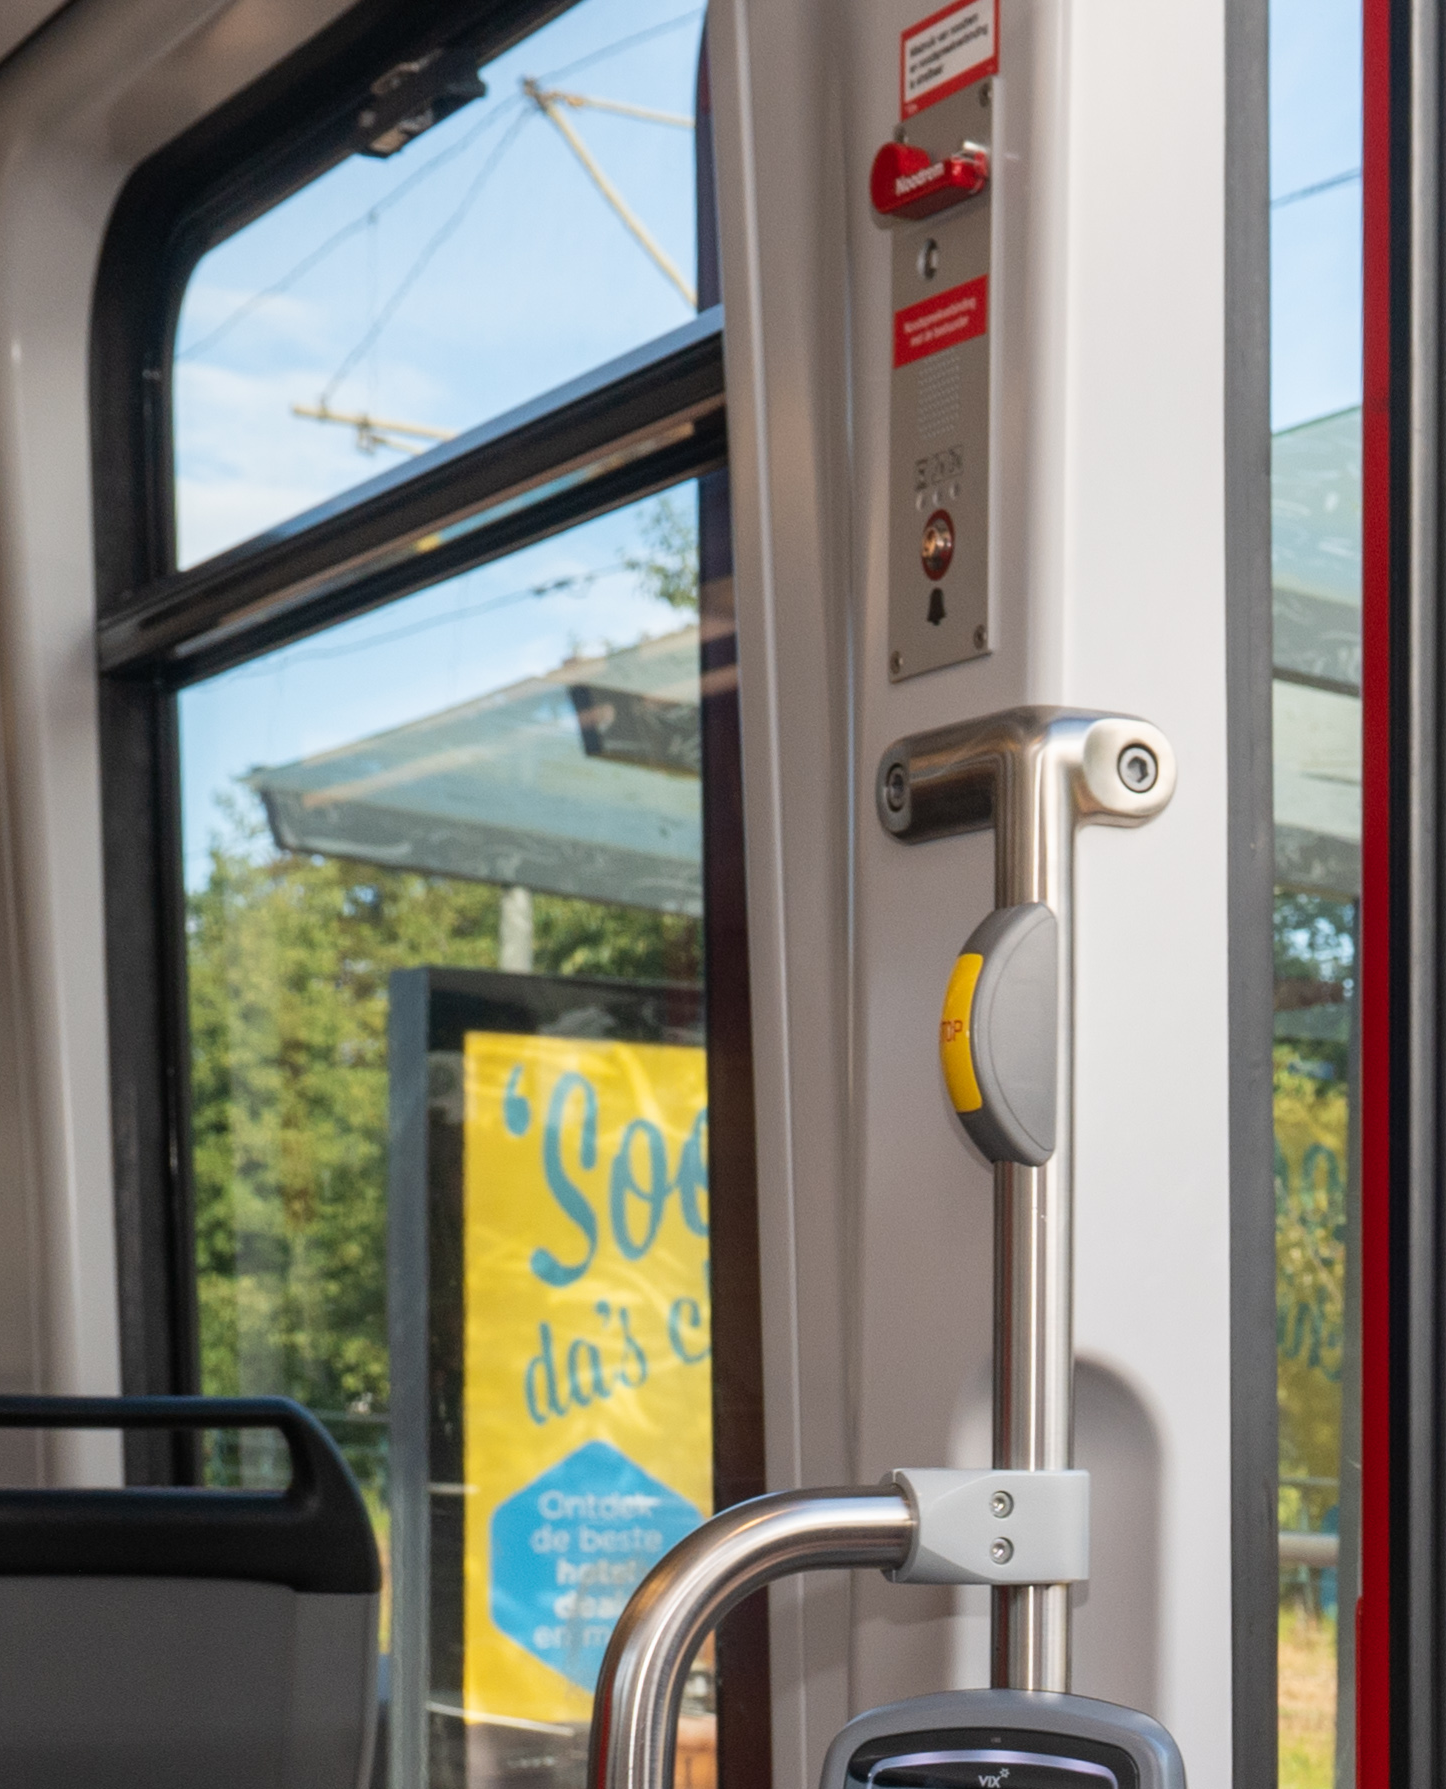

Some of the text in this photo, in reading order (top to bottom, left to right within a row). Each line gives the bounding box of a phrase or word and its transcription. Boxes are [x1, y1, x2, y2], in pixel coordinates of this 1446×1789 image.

[530, 1524, 663, 1554] de beste
[557, 1558, 637, 1585] hotel
